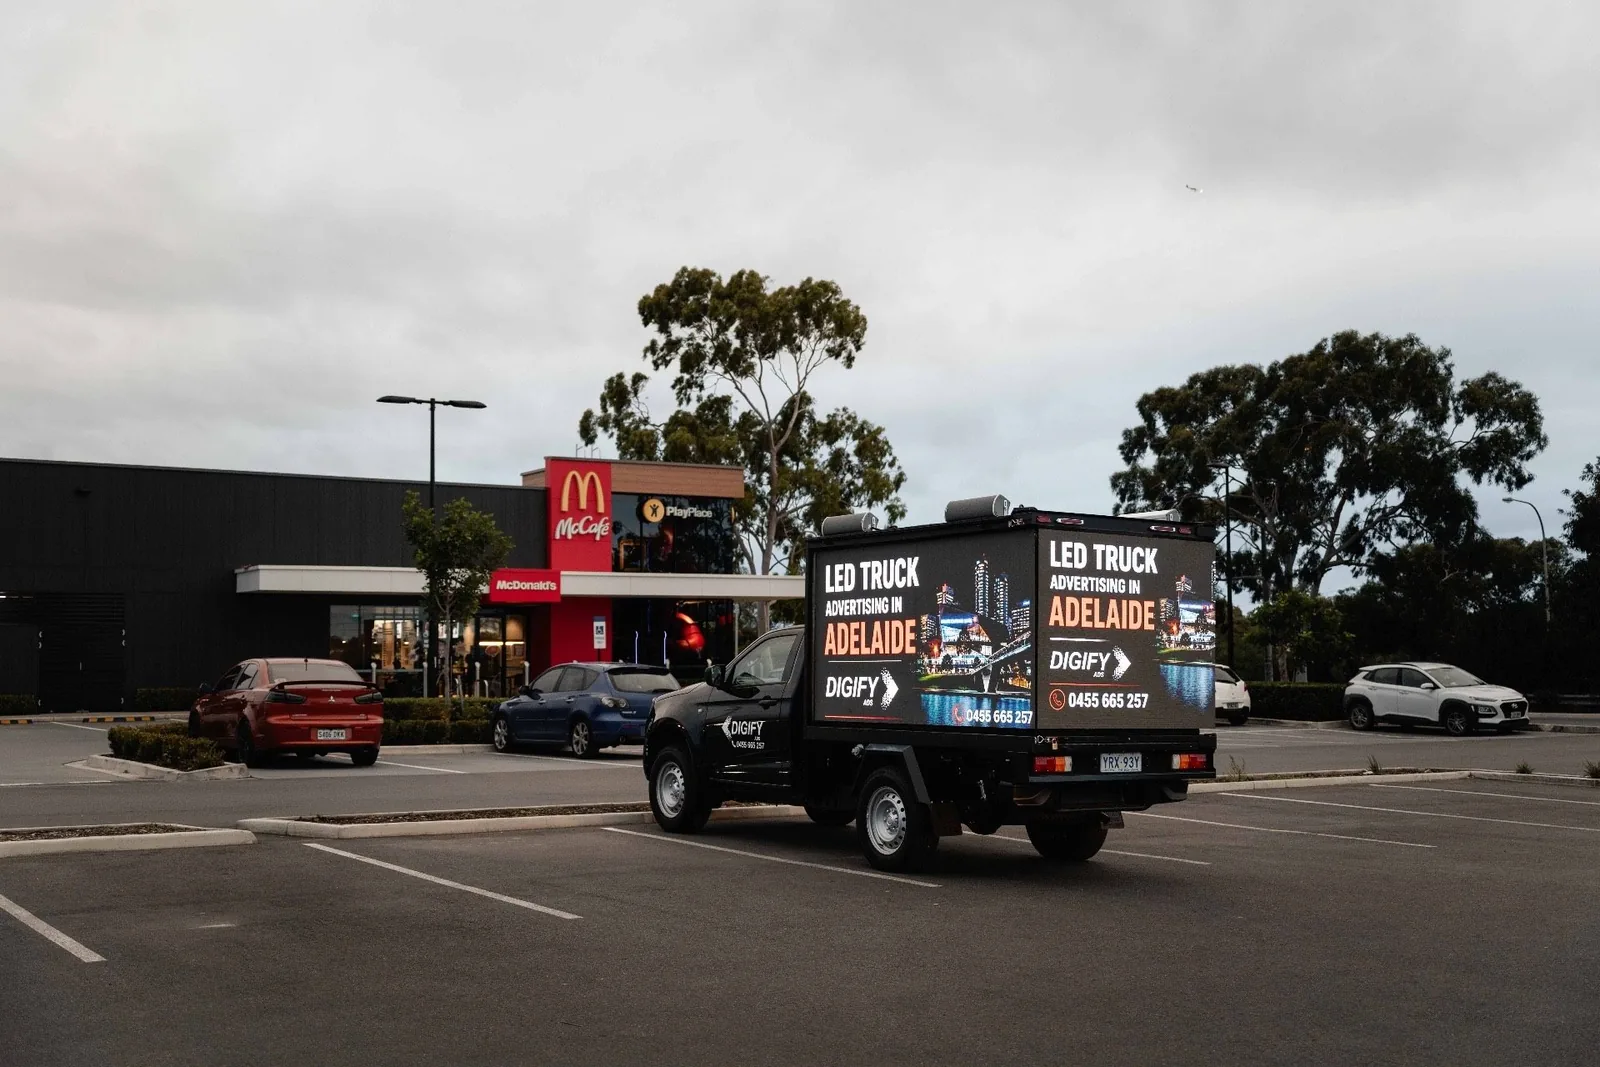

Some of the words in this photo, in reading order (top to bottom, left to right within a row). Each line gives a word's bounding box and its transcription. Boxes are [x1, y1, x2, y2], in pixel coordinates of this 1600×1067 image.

[666, 506, 713, 519] PlayPlace
[555, 516, 611, 541] McCafé
[1050, 540, 1088, 570] LED
[1093, 543, 1159, 574] TRUCK
[825, 562, 856, 593] LED
[860, 556, 920, 591] TRUCK
[1050, 574, 1126, 594] ADVERTISING
[1128, 579, 1141, 595] IN
[496, 580, 557, 591] McDonald's
[825, 596, 889, 617] ADVERTISING
[891, 595, 903, 614] IN
[1048, 595, 1155, 631] ADELAIDE
[824, 618, 916, 656] ADELAIDE
[1049, 650, 1111, 671] DIGIFY
[825, 676, 879, 698] DIGIFY
[1068, 692, 1099, 708] 0455
[1101, 693, 1124, 709] 665
[1126, 693, 1149, 709] 257
[966, 709, 992, 722] 0455
[993, 710, 1013, 723] 665
[1015, 710, 1034, 725] 257
[731, 720, 766, 736] DIGIFY
